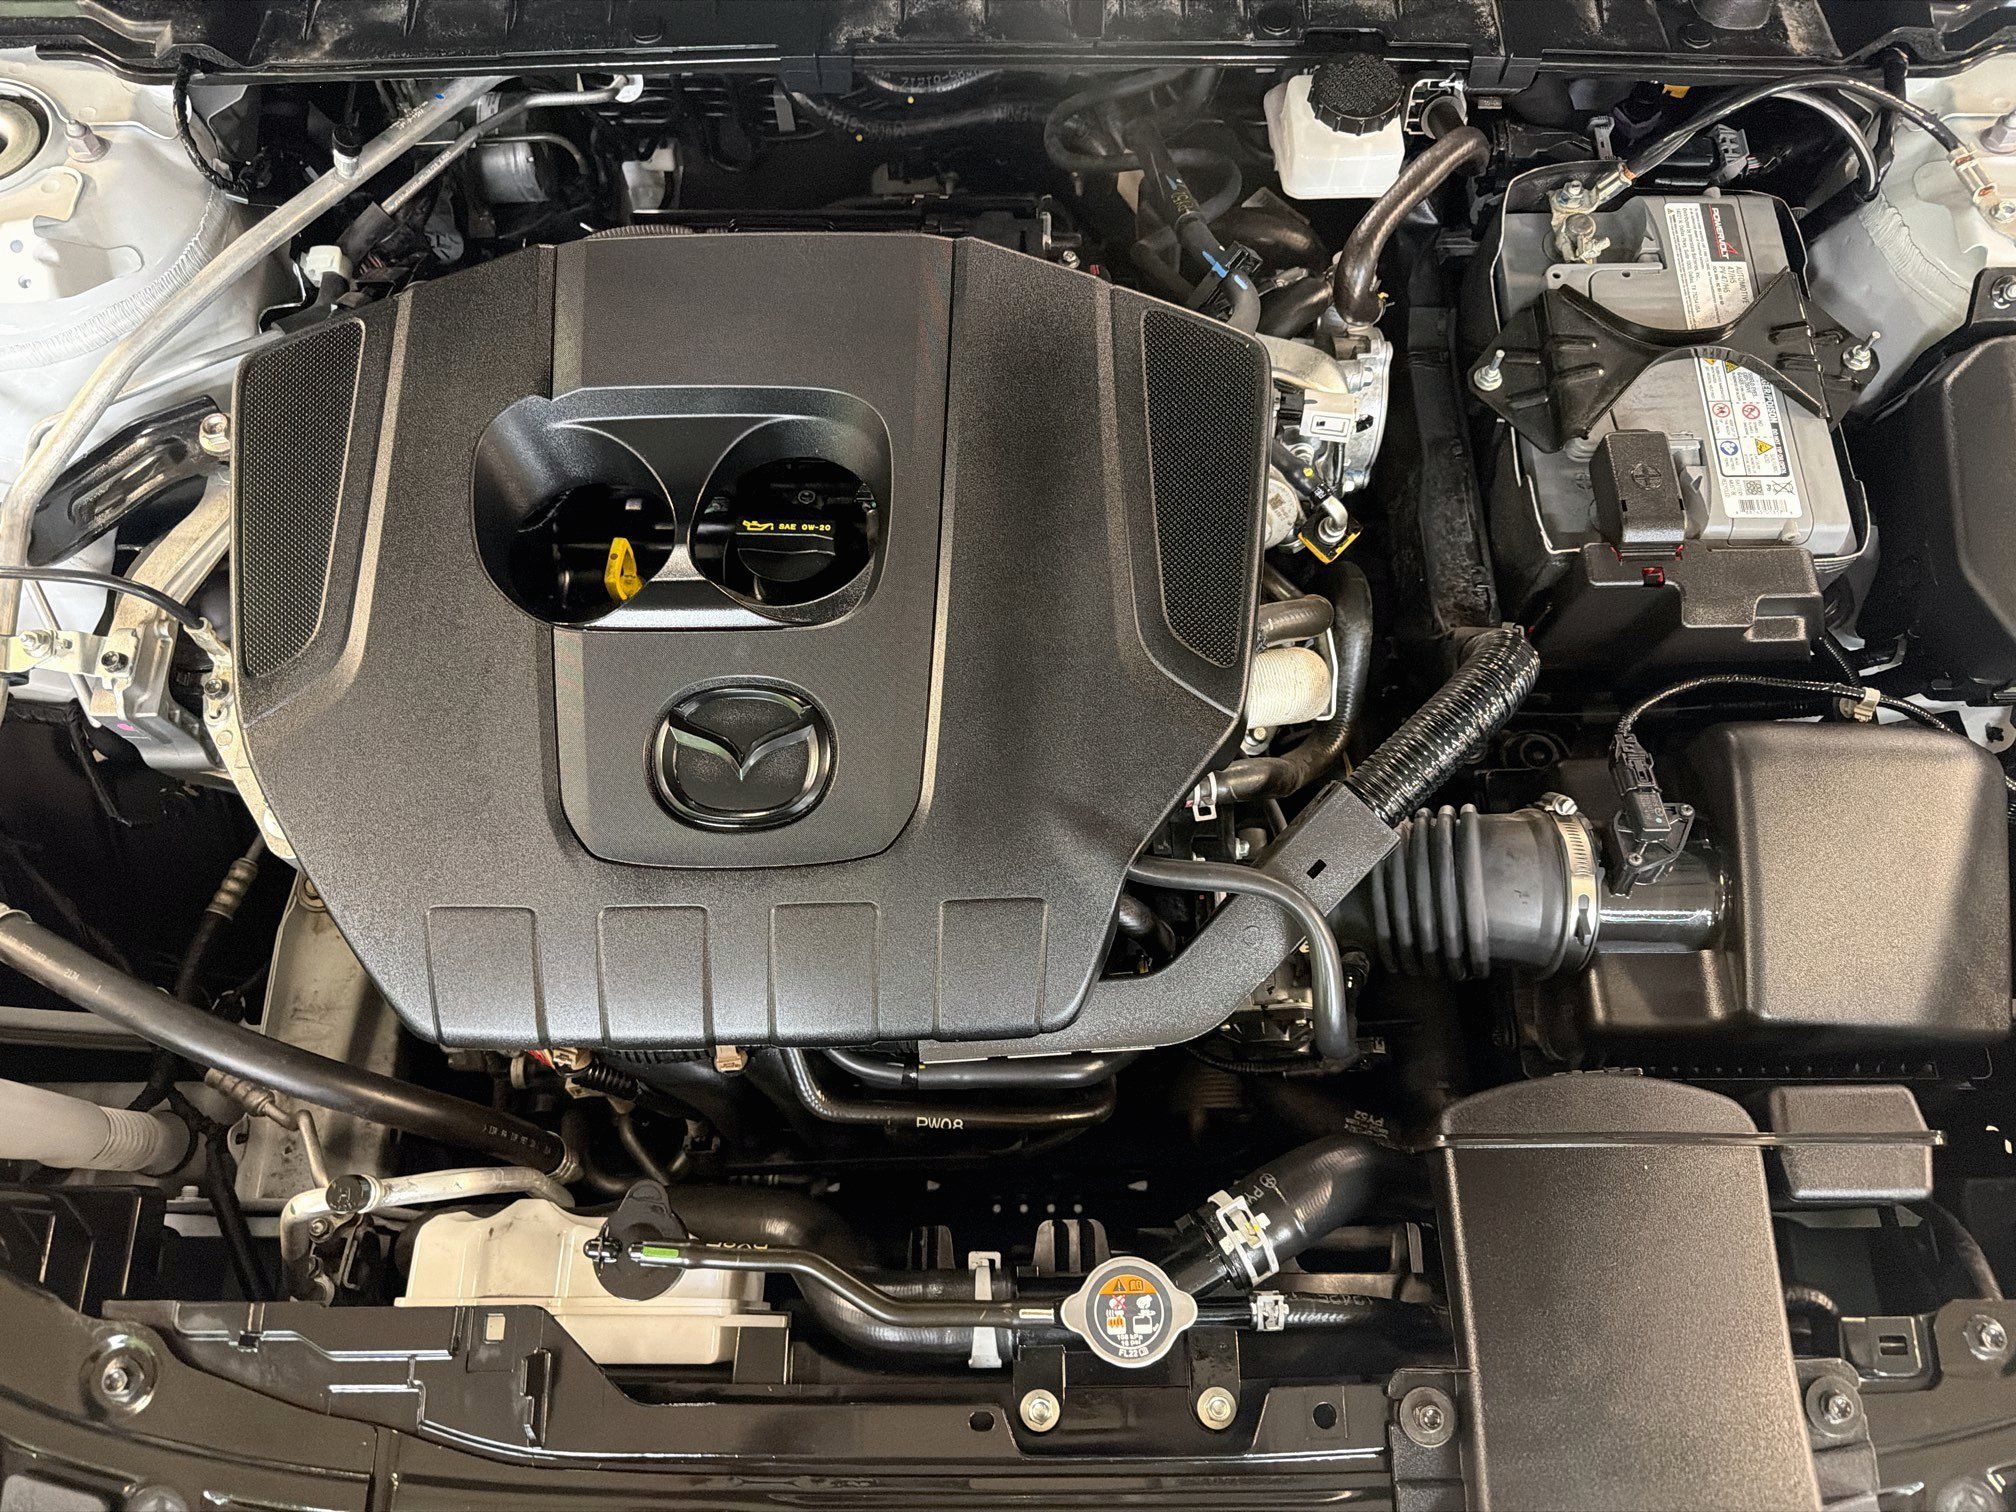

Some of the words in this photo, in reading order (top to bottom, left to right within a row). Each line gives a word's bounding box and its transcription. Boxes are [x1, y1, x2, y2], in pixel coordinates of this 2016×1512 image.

[1711, 207, 1729, 259] POWERVOLT
[1735, 265, 1749, 303] AUTOMOTIVE
[778, 523, 797, 531] SAE
[801, 523, 831, 531] 0W-20
[1118, 1348, 1138, 1358] FL22
